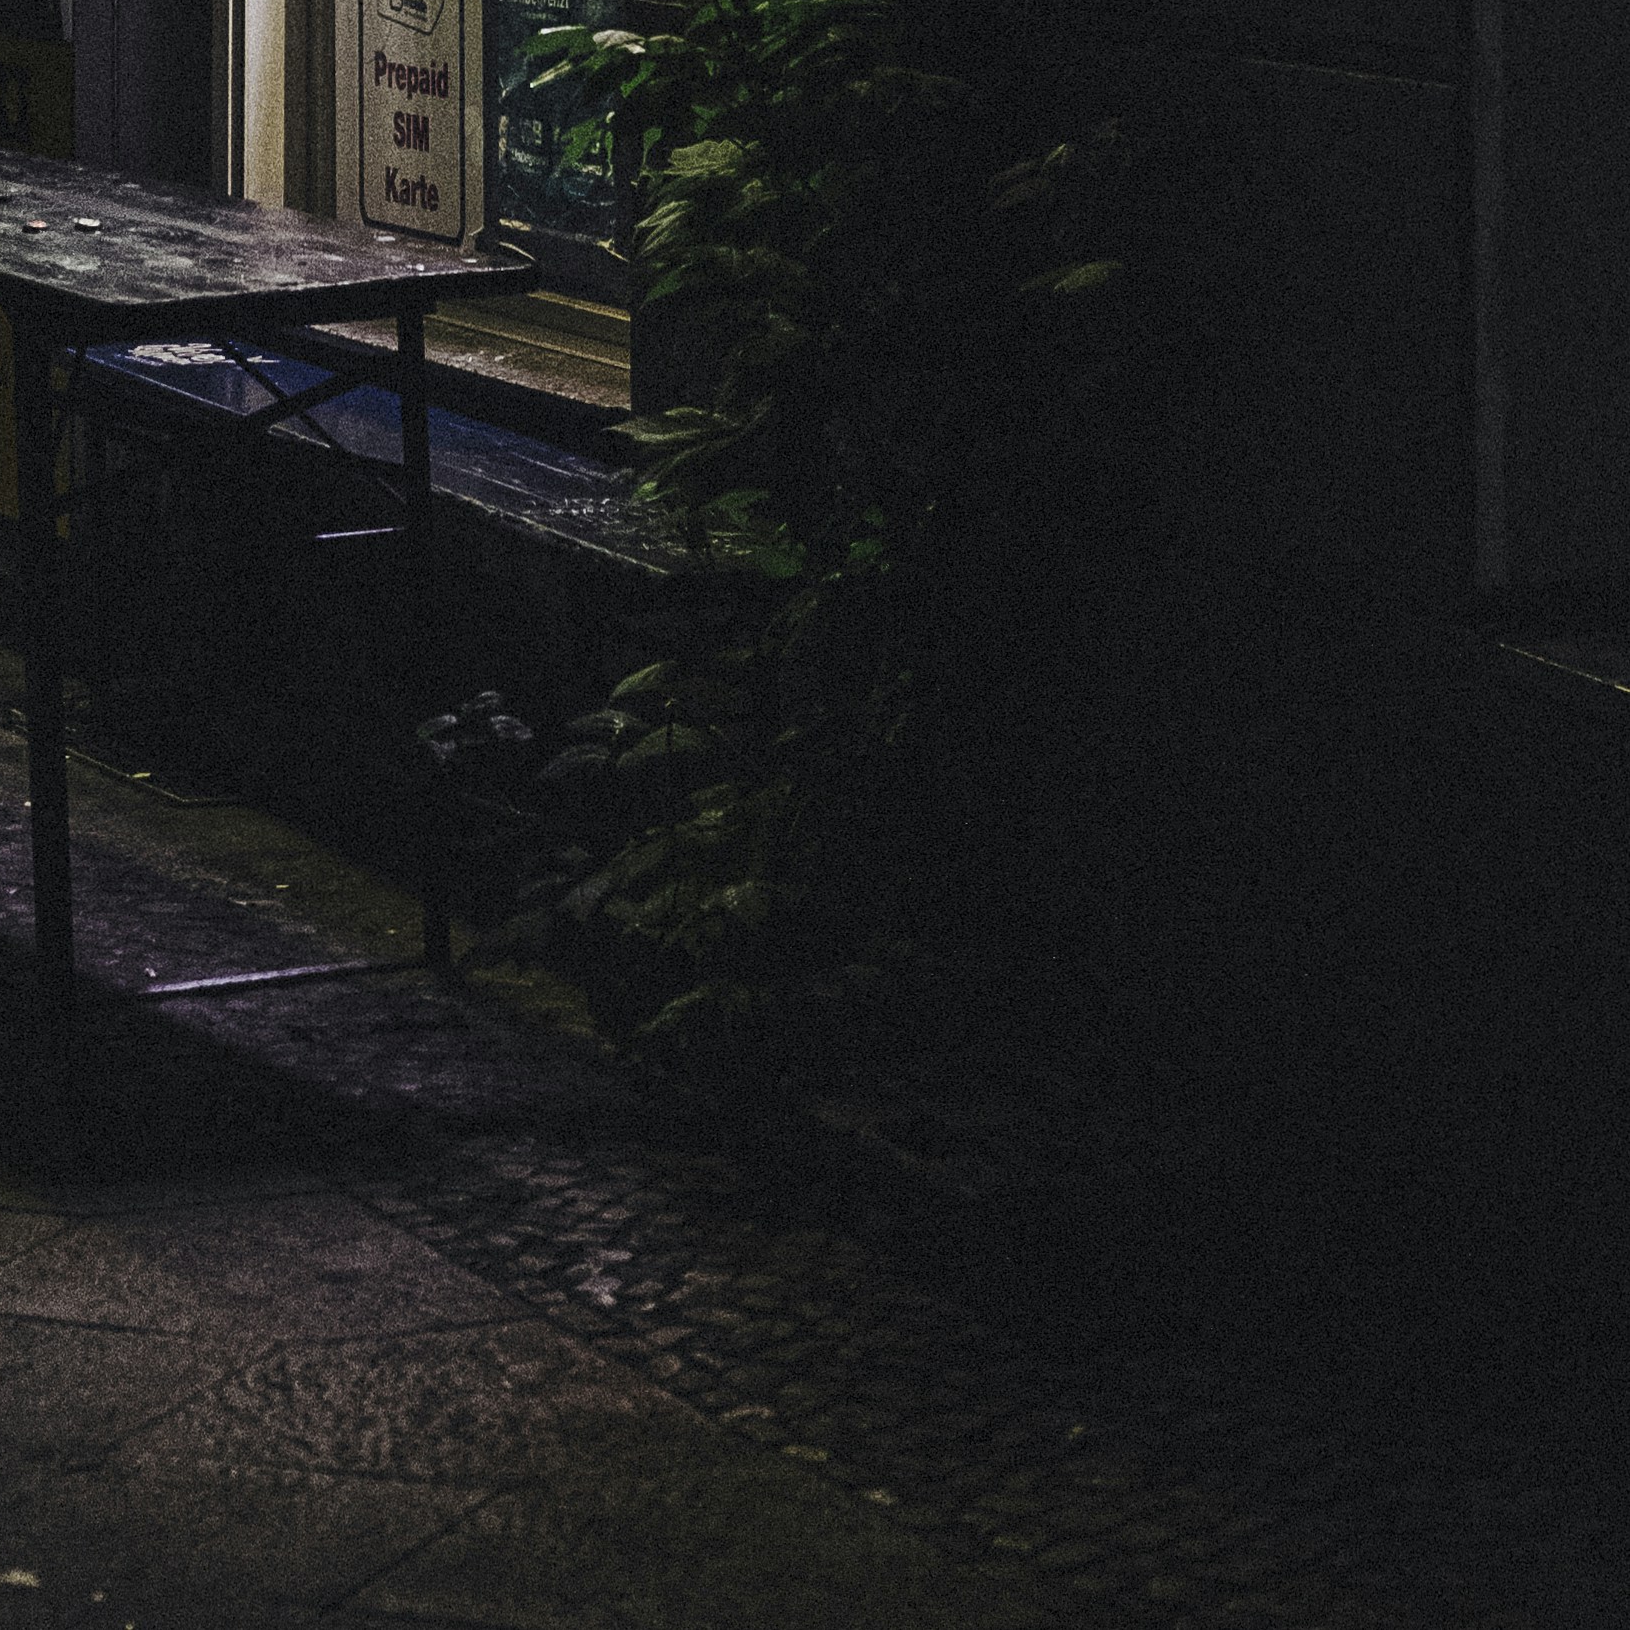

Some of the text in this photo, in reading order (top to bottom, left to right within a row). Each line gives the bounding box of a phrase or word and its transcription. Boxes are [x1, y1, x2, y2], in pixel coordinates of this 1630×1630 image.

[373, 51, 450, 99] Prepaid
[392, 111, 430, 154] SIM
[384, 165, 440, 212] Karte
